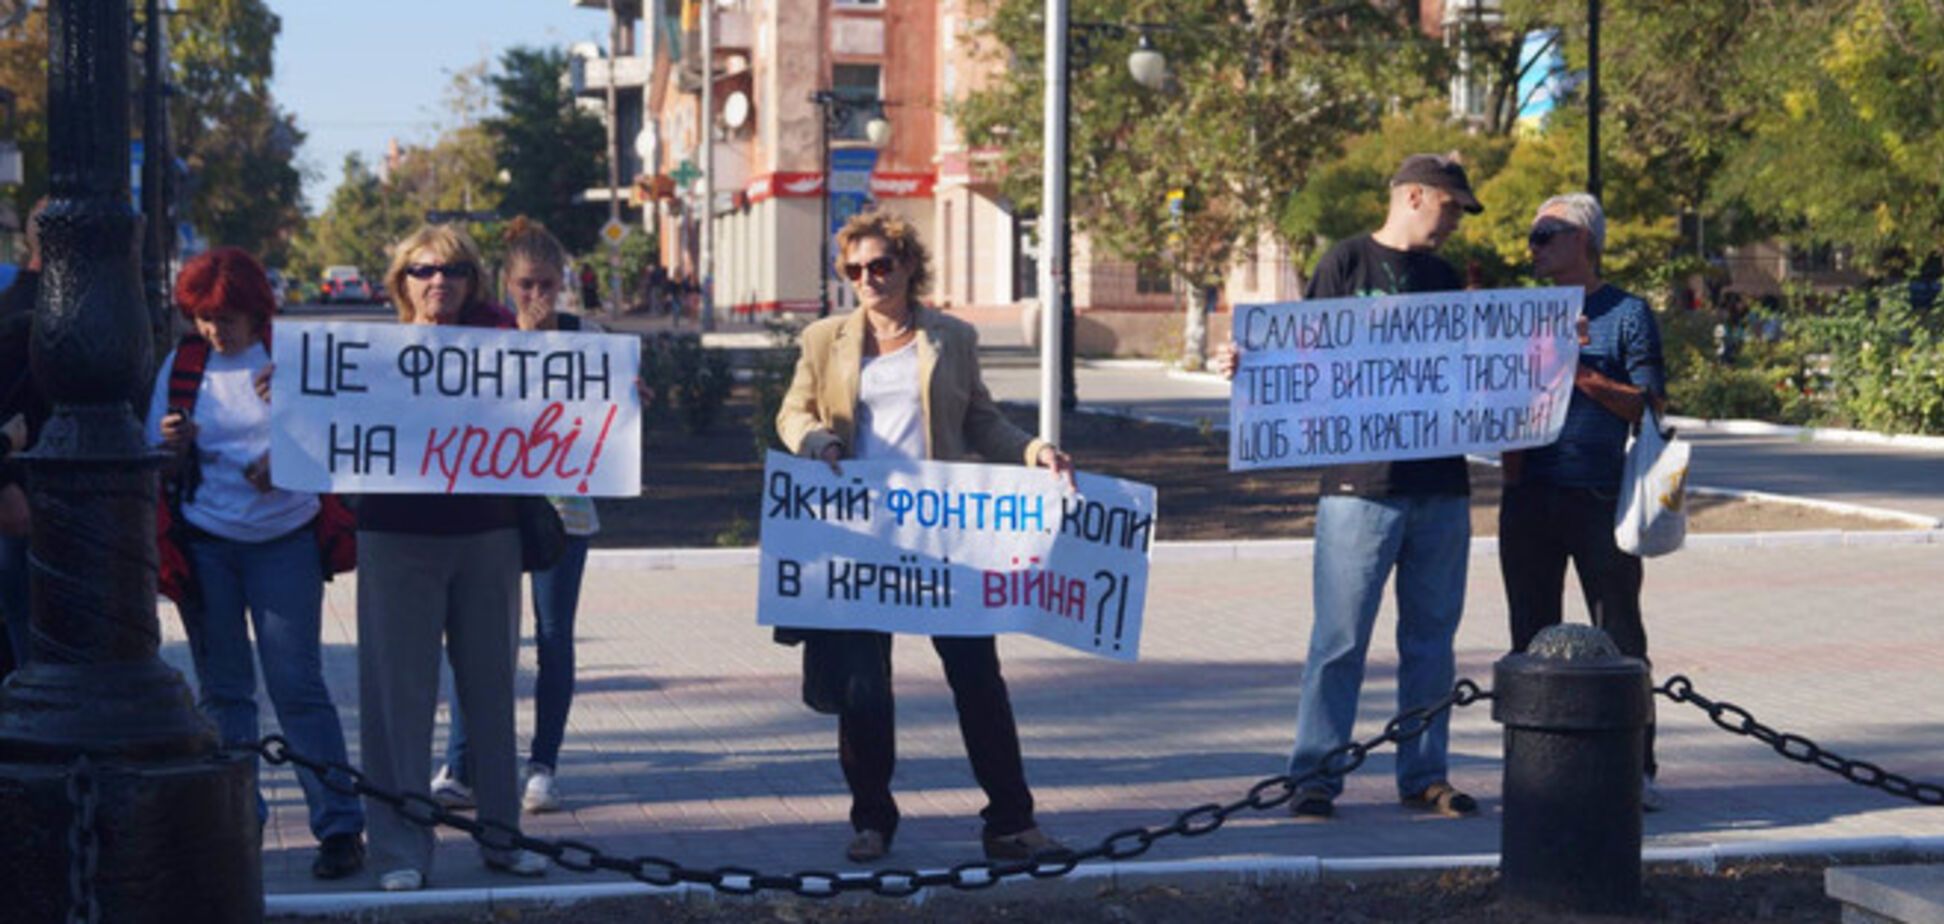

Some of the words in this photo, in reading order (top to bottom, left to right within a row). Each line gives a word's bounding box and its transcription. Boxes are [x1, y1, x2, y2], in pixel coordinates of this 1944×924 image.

[1369, 303, 1468, 345] НАКРАВ
[302, 331, 370, 397] ЦЕ
[397, 344, 610, 401] ФОНТАН
[1243, 361, 1319, 405] ТЕПЕР
[1331, 355, 1450, 399] ВИТРАЧАЄ
[328, 422, 397, 475] НА
[419, 400, 618, 494] крові!
[1238, 418, 1289, 464] ЩОБ
[1297, 414, 1353, 457] ЗНОВ
[1359, 410, 1439, 452] КРАСТИ
[768, 470, 870, 522] ЯКИЙ
[1060, 496, 1153, 554] КОЛИ
[777, 559, 802, 599] В
[828, 557, 951, 609] КРАЇНІ
[982, 556, 1129, 651] ВІЙНА?!
